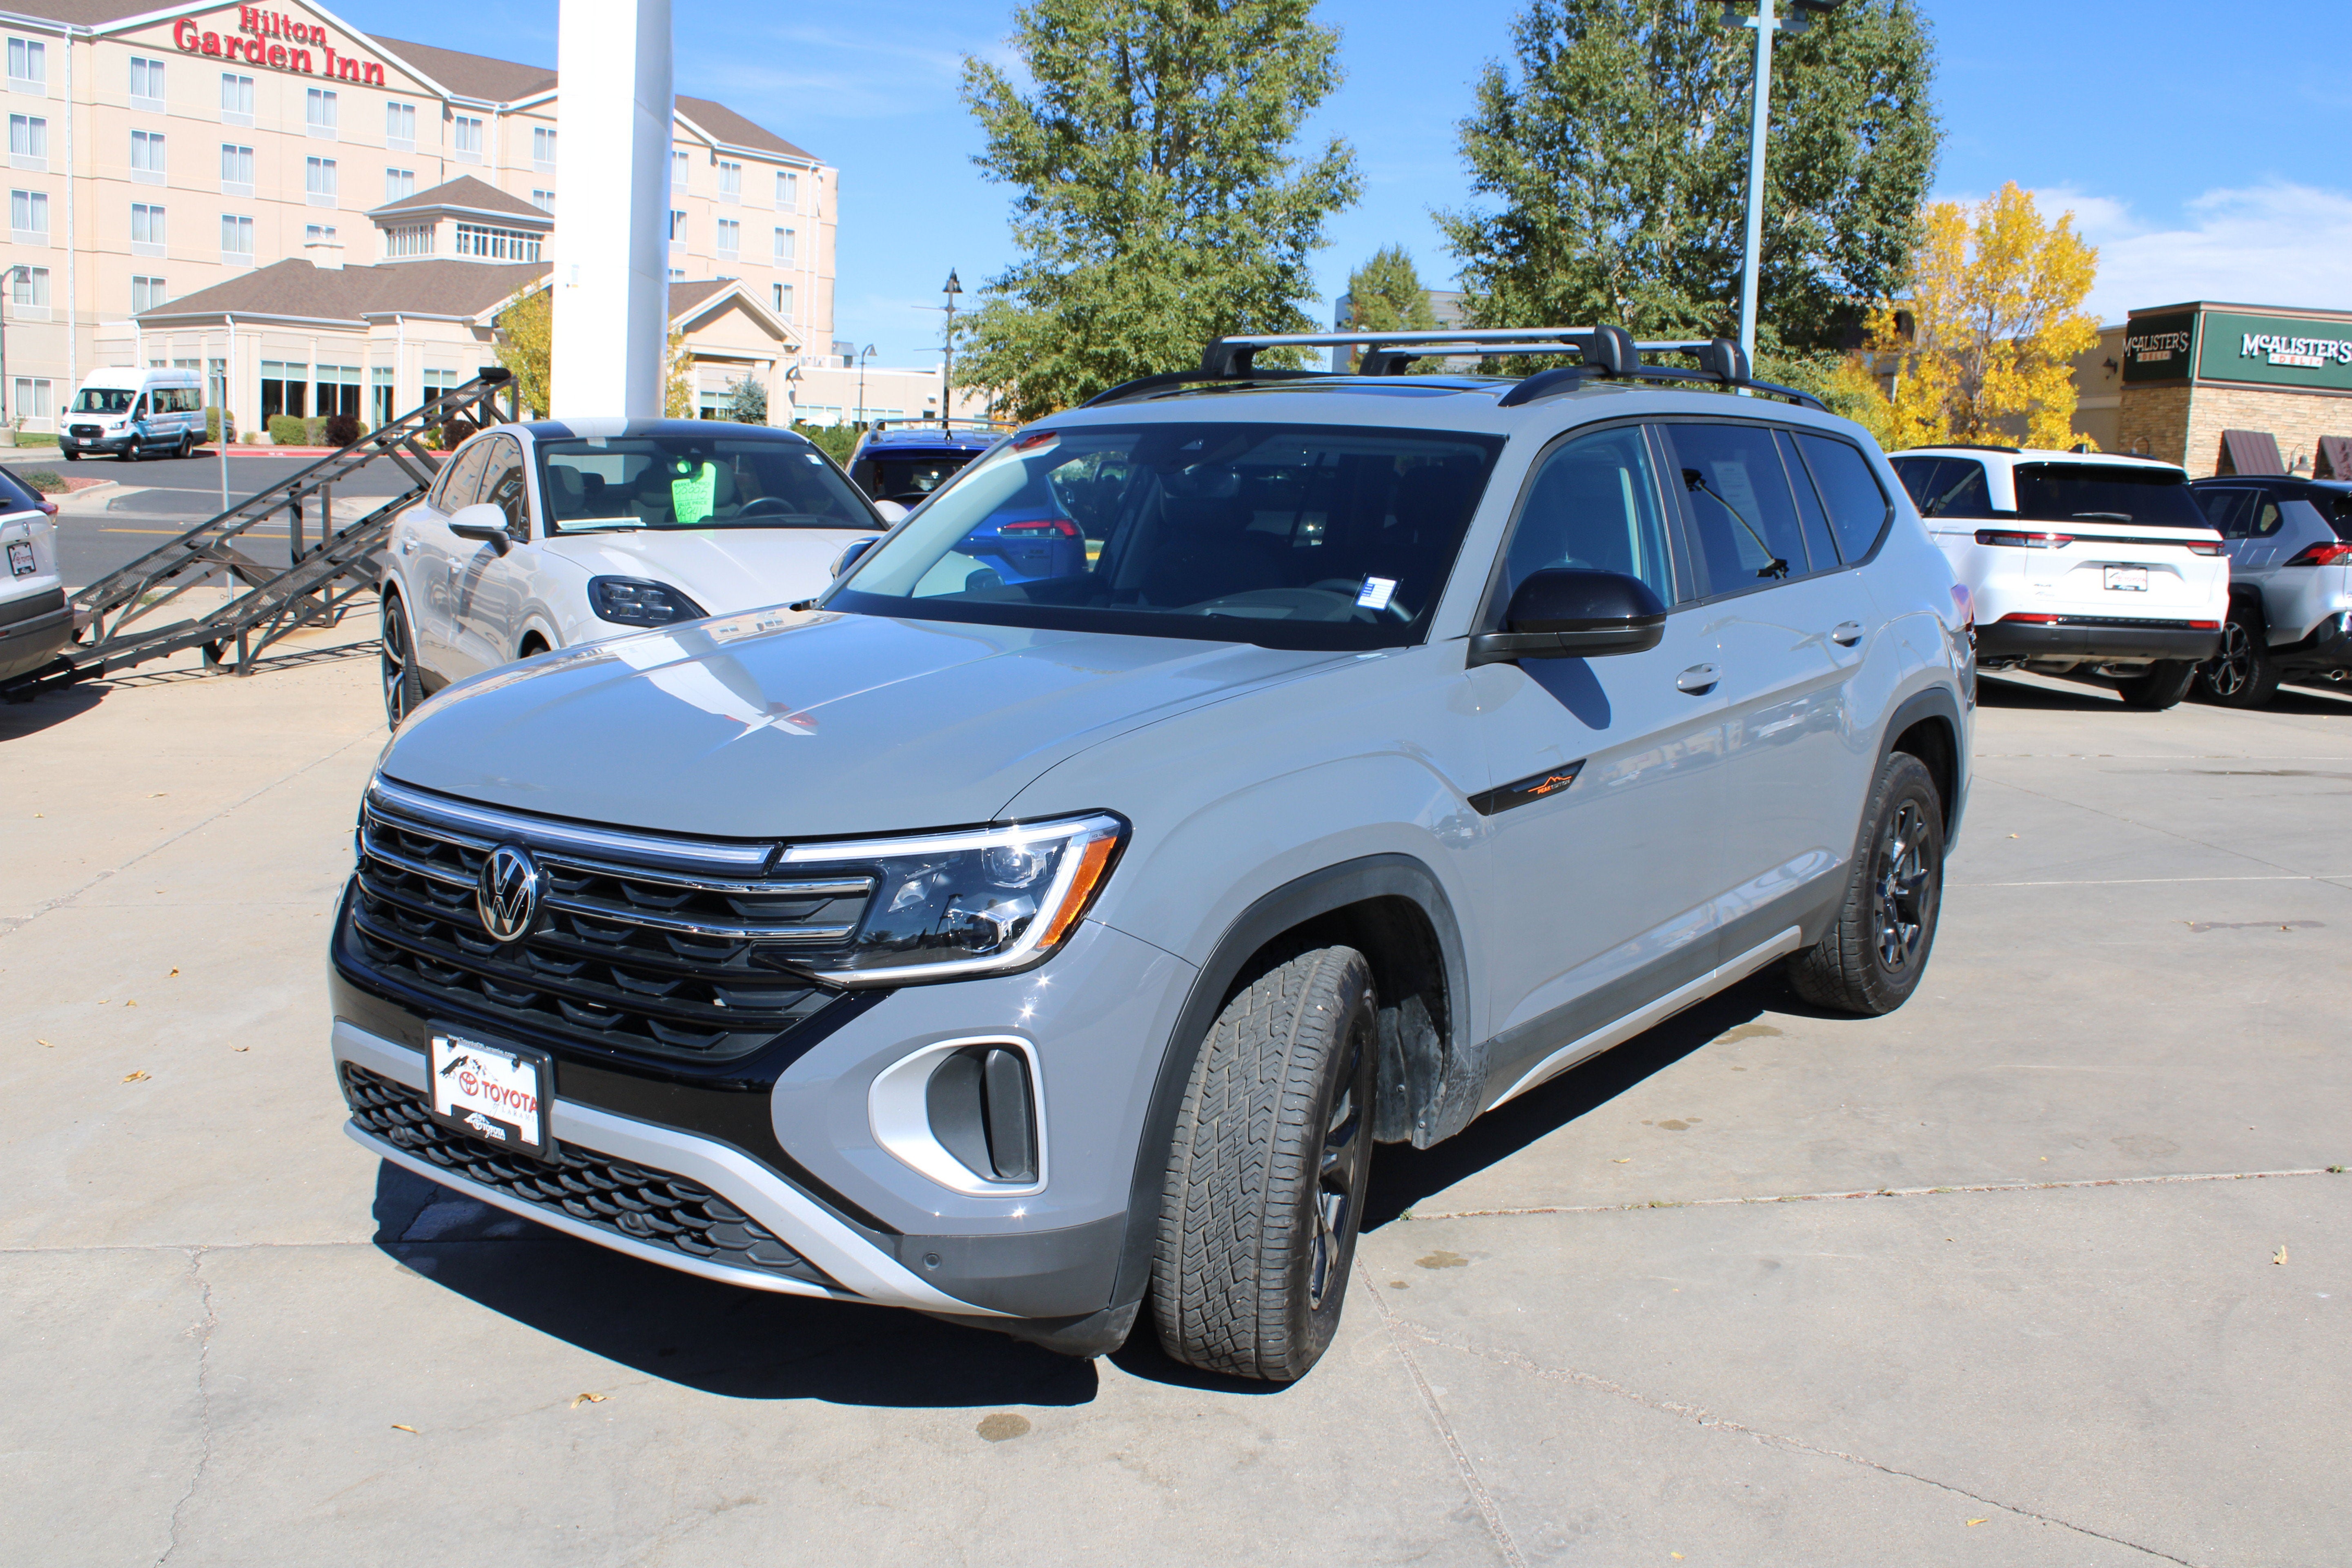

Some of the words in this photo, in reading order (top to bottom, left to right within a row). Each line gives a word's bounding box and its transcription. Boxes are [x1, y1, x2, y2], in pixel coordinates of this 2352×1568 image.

[238, 4, 327, 43] Hilton
[173, 18, 313, 73] Garden
[323, 46, 385, 87] Inn
[2279, 356, 2313, 365] DELI
[1537, 785, 1551, 794] PEAK
[1551, 778, 1570, 789] EDITION
[481, 1080, 537, 1113] TOYOTA
[502, 1106, 534, 1122] LARAMI
